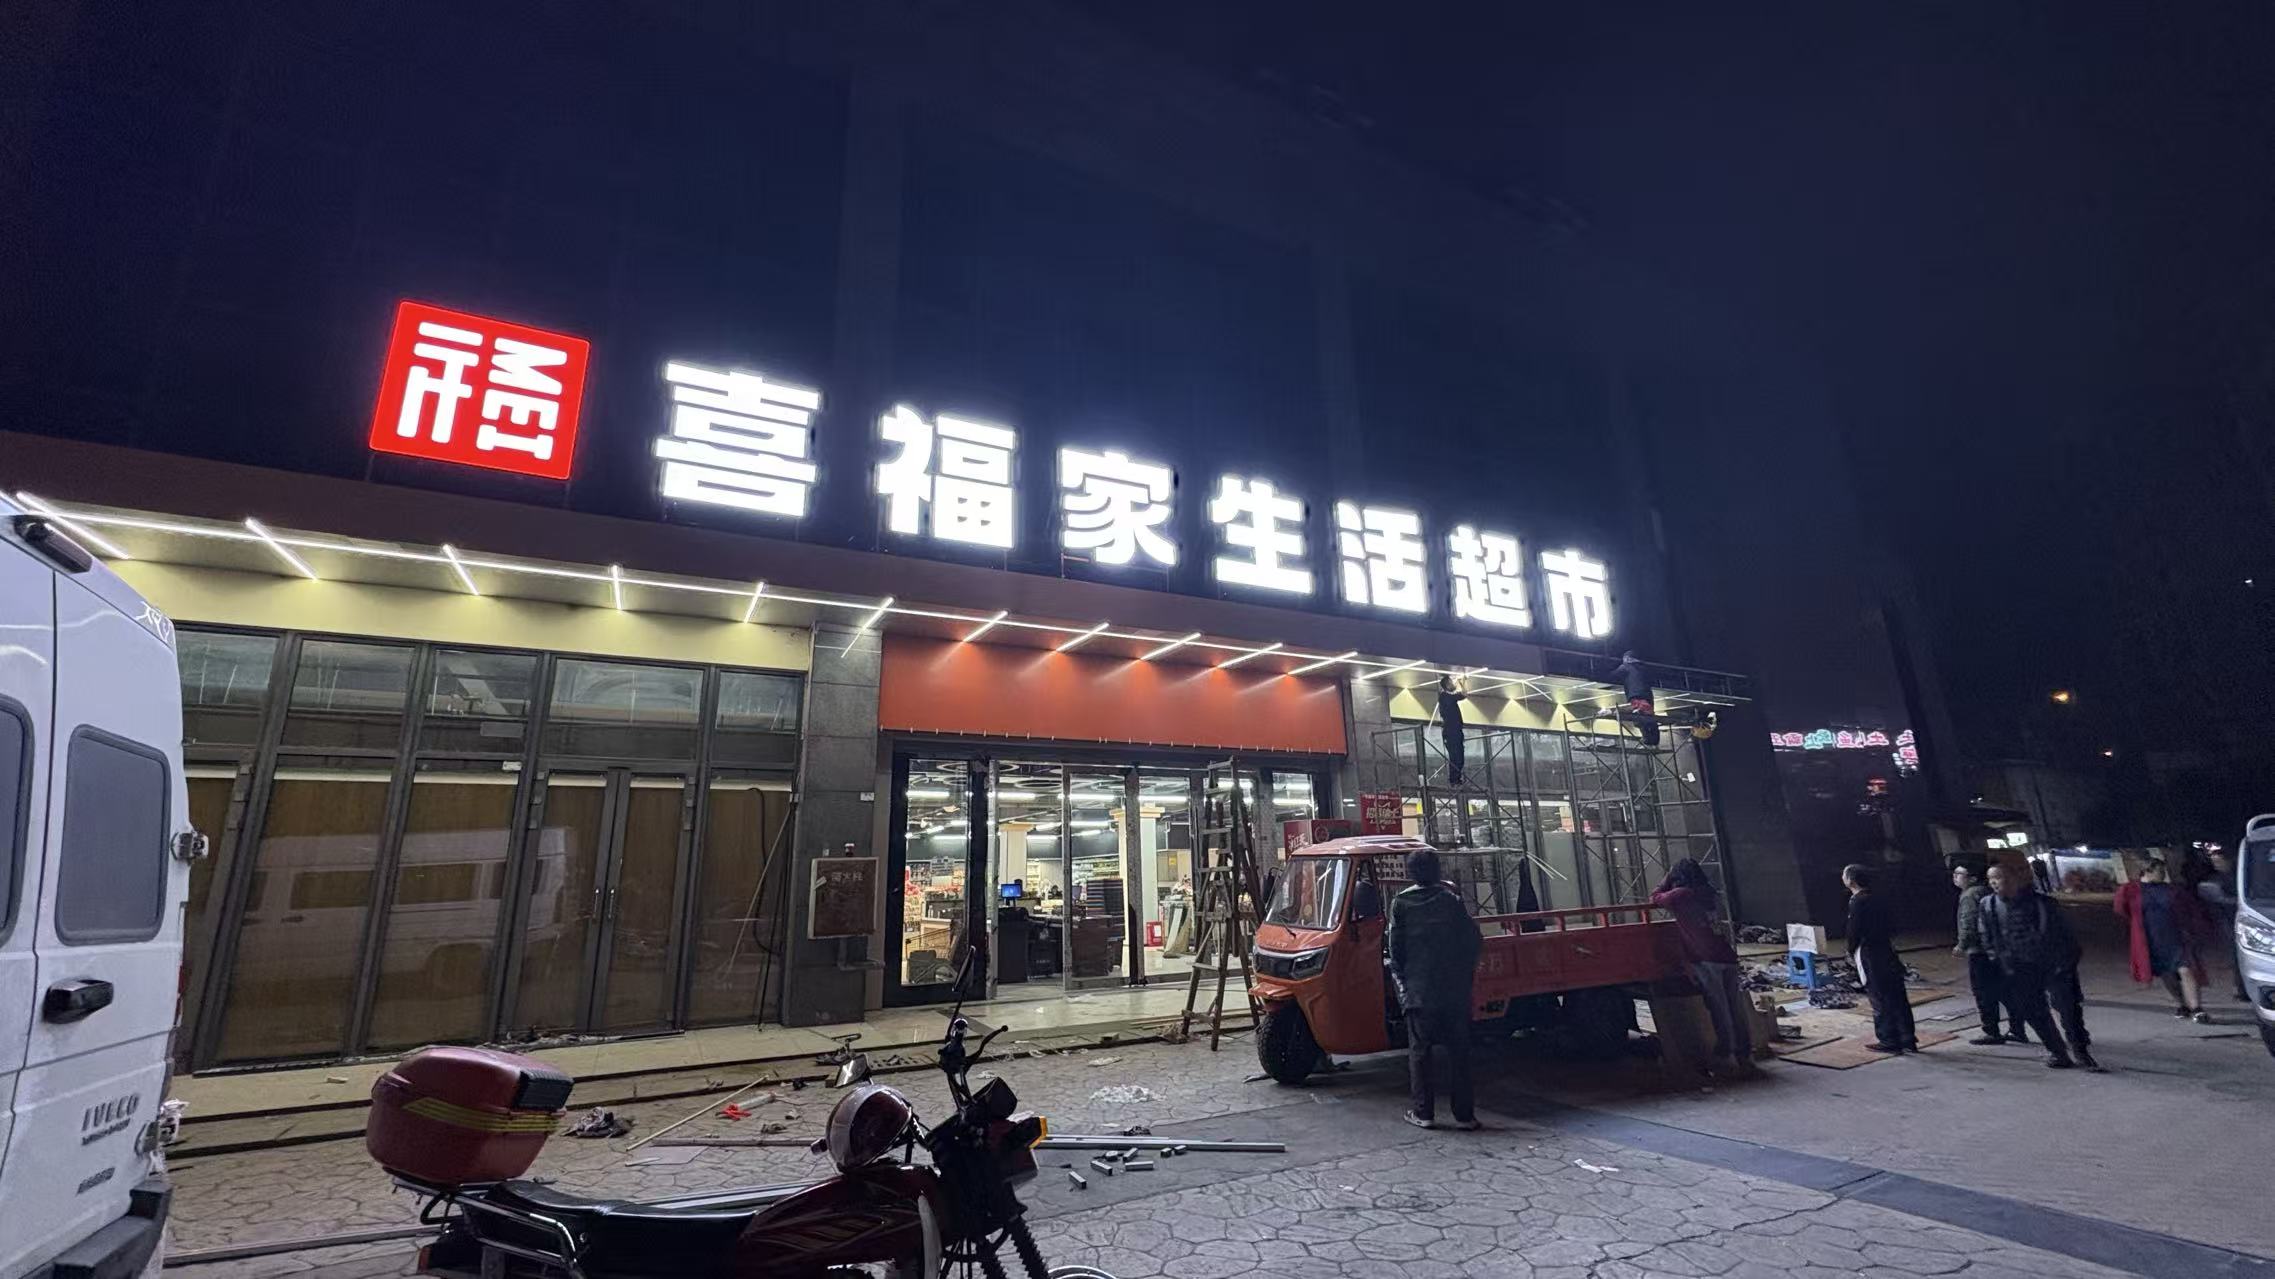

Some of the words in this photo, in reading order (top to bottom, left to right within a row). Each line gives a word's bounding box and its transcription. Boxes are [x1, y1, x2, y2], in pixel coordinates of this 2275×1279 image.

[655, 361, 1613, 639] 喜福家生活超市
[82, 1094, 140, 1131] IVECO
